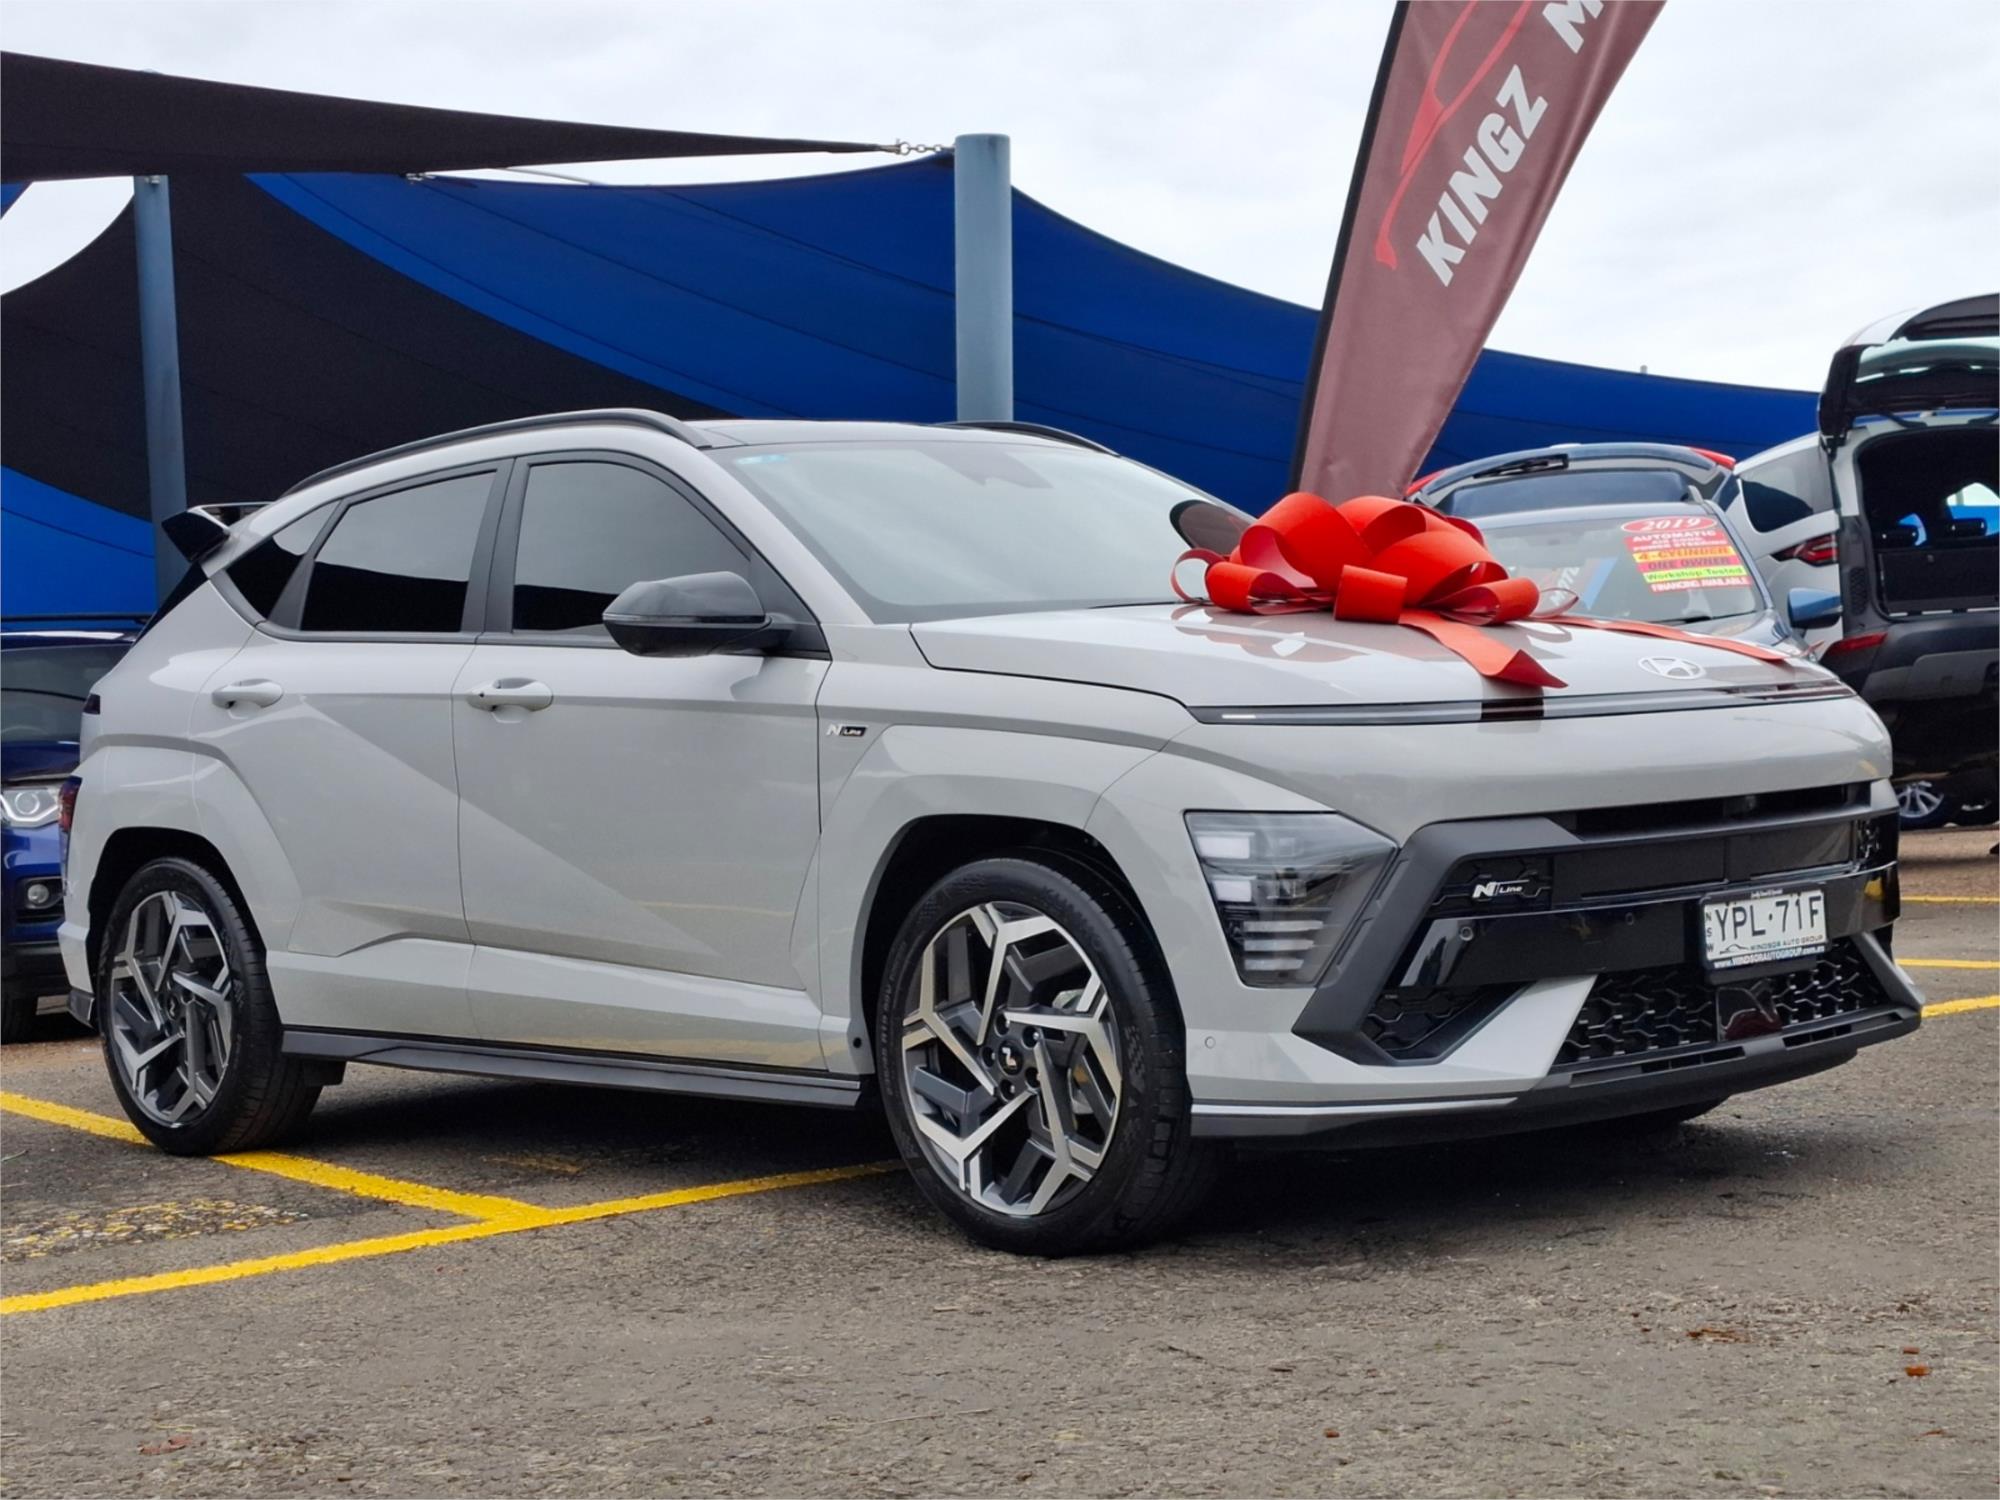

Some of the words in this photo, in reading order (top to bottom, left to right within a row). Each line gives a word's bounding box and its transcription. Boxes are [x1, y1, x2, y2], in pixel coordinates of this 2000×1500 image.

[1416, 64, 1548, 287] KINGZ
[1641, 518, 1702, 532] 2019
[1632, 530, 1717, 542] AUTOMATIC
[1680, 556, 1729, 568] OWNER
[1648, 569, 1703, 581] Workshop
[1706, 566, 1744, 576] Tested
[1472, 882, 1498, 898] N
[1750, 941, 1781, 951] WINDSOR
[1782, 937, 1800, 946] AUTO
[1801, 934, 1824, 944] GROUP
